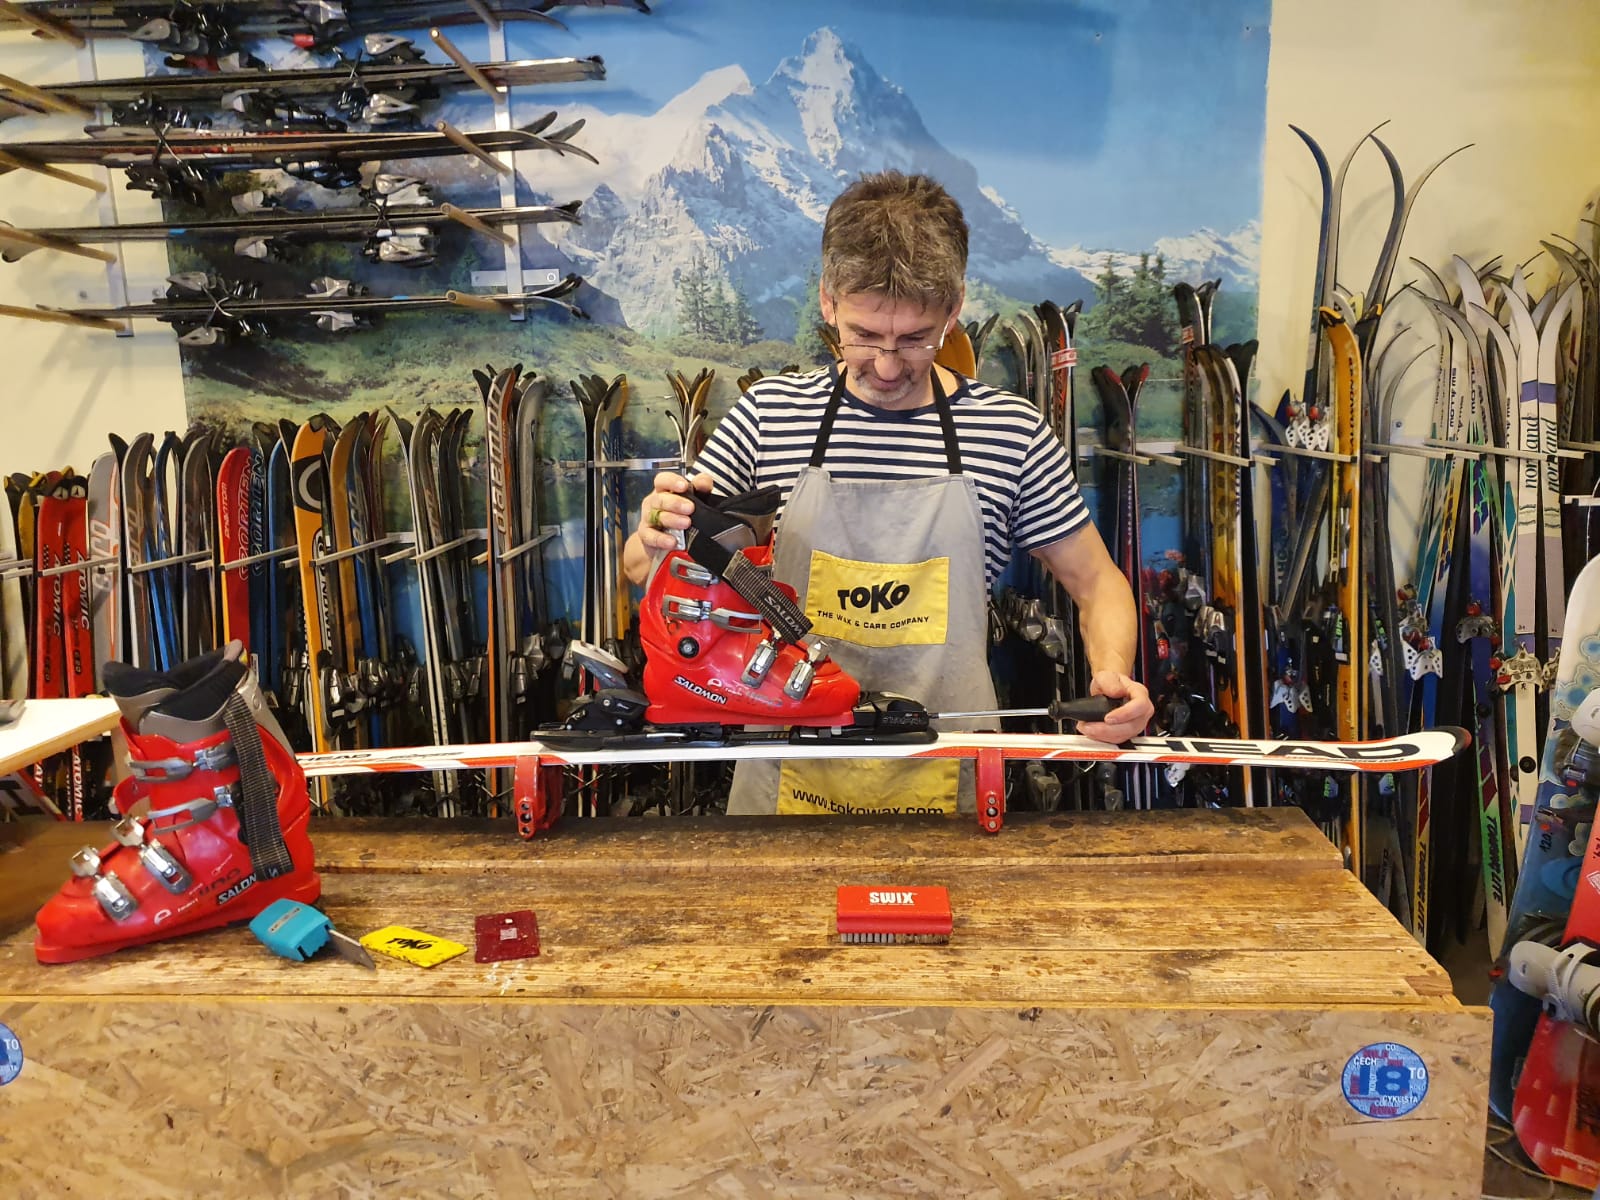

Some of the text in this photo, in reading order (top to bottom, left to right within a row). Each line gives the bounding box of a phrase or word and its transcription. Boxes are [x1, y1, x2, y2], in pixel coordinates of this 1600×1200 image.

[1521, 416, 1538, 488] norand
[837, 580, 911, 614] TOKO
[817, 610, 834, 619] THE
[837, 613, 852, 626] WAX
[864, 621, 887, 630] CARE
[890, 615, 929, 629] COMPANY
[674, 675, 727, 705] SALOMON
[1117, 739, 1421, 761] HEAD
[869, 891, 915, 905] SWIX
[386, 937, 433, 950] TOKO
[1408, 1066, 1426, 1080] TO
